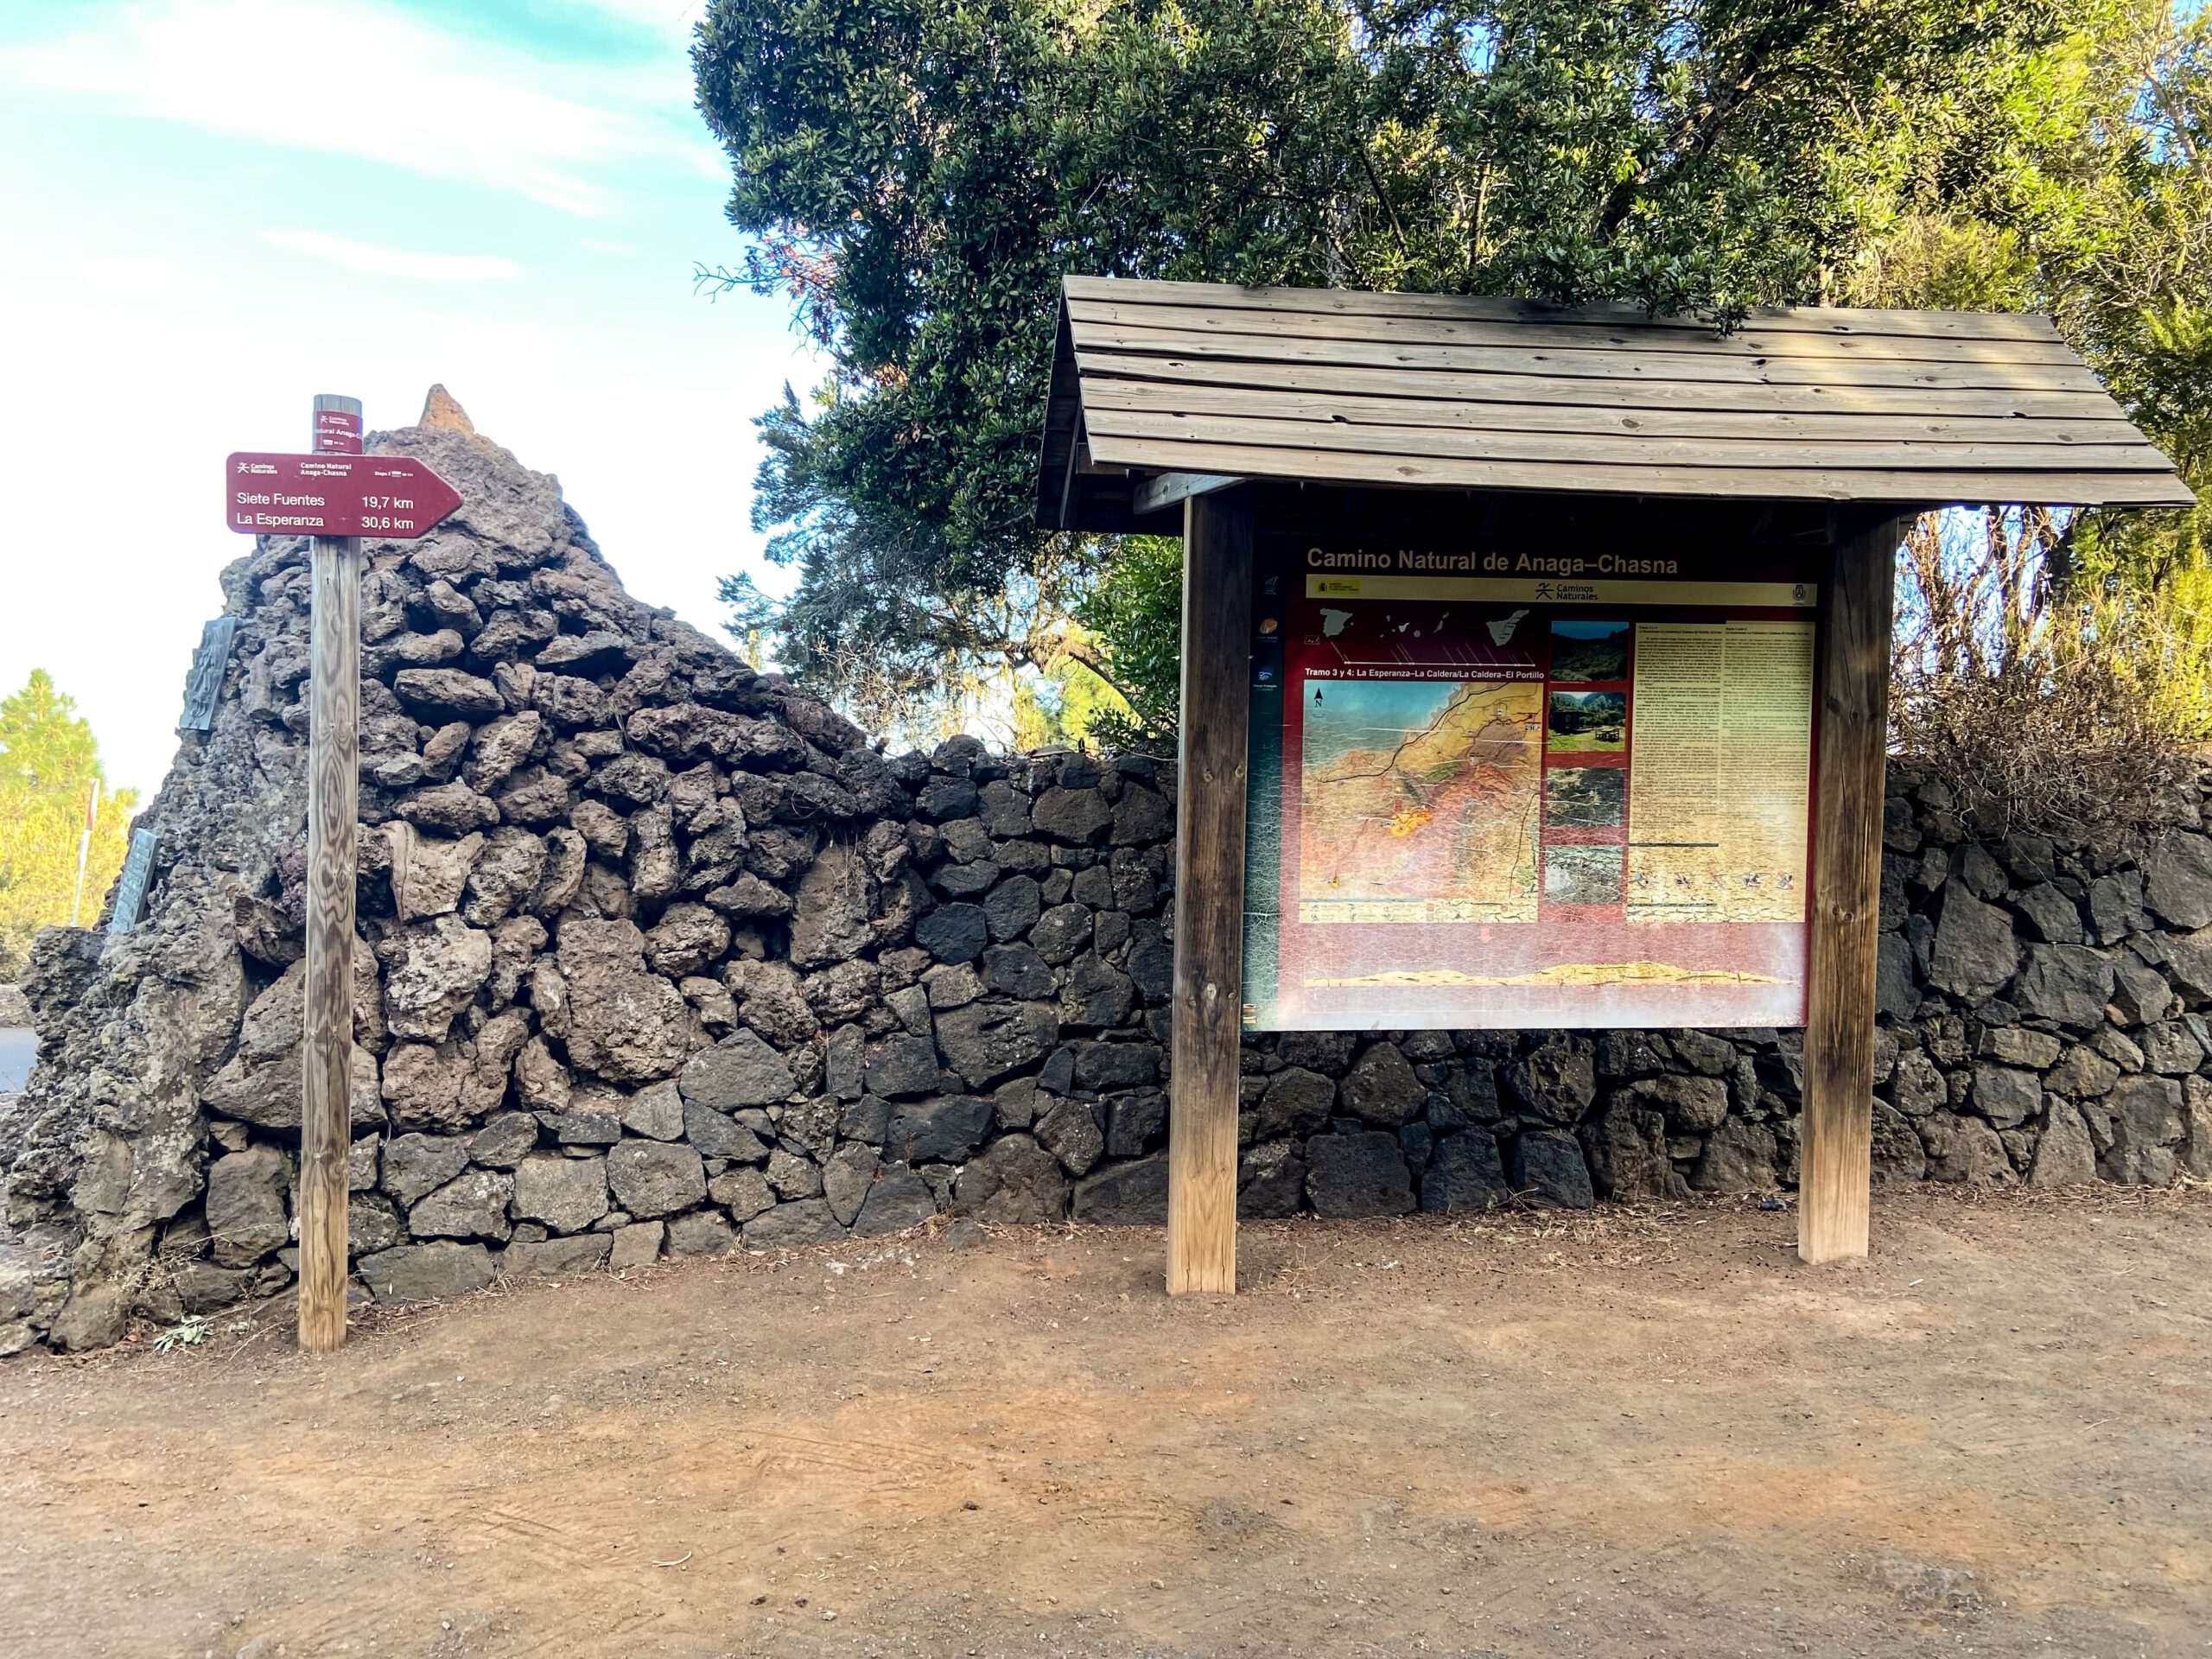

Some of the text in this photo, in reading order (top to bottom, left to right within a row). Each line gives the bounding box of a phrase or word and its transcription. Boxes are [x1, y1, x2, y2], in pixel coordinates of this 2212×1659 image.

[237, 493, 326, 506] Siete Fuentes
[362, 496, 414, 510] 19,7 km
[237, 512, 325, 528] La Esperanza
[361, 516, 414, 531] 30,6 km
[1307, 548, 1391, 569] Camino
[1398, 550, 1476, 570] Natural
[1483, 552, 1509, 570] de
[1556, 583, 1594, 593] Caminos
[1556, 591, 1599, 601] Naturales
[1305, 668, 1331, 677] Tramo
[1339, 670, 1345, 678] y
[1427, 670, 1469, 678] Caldera/La
